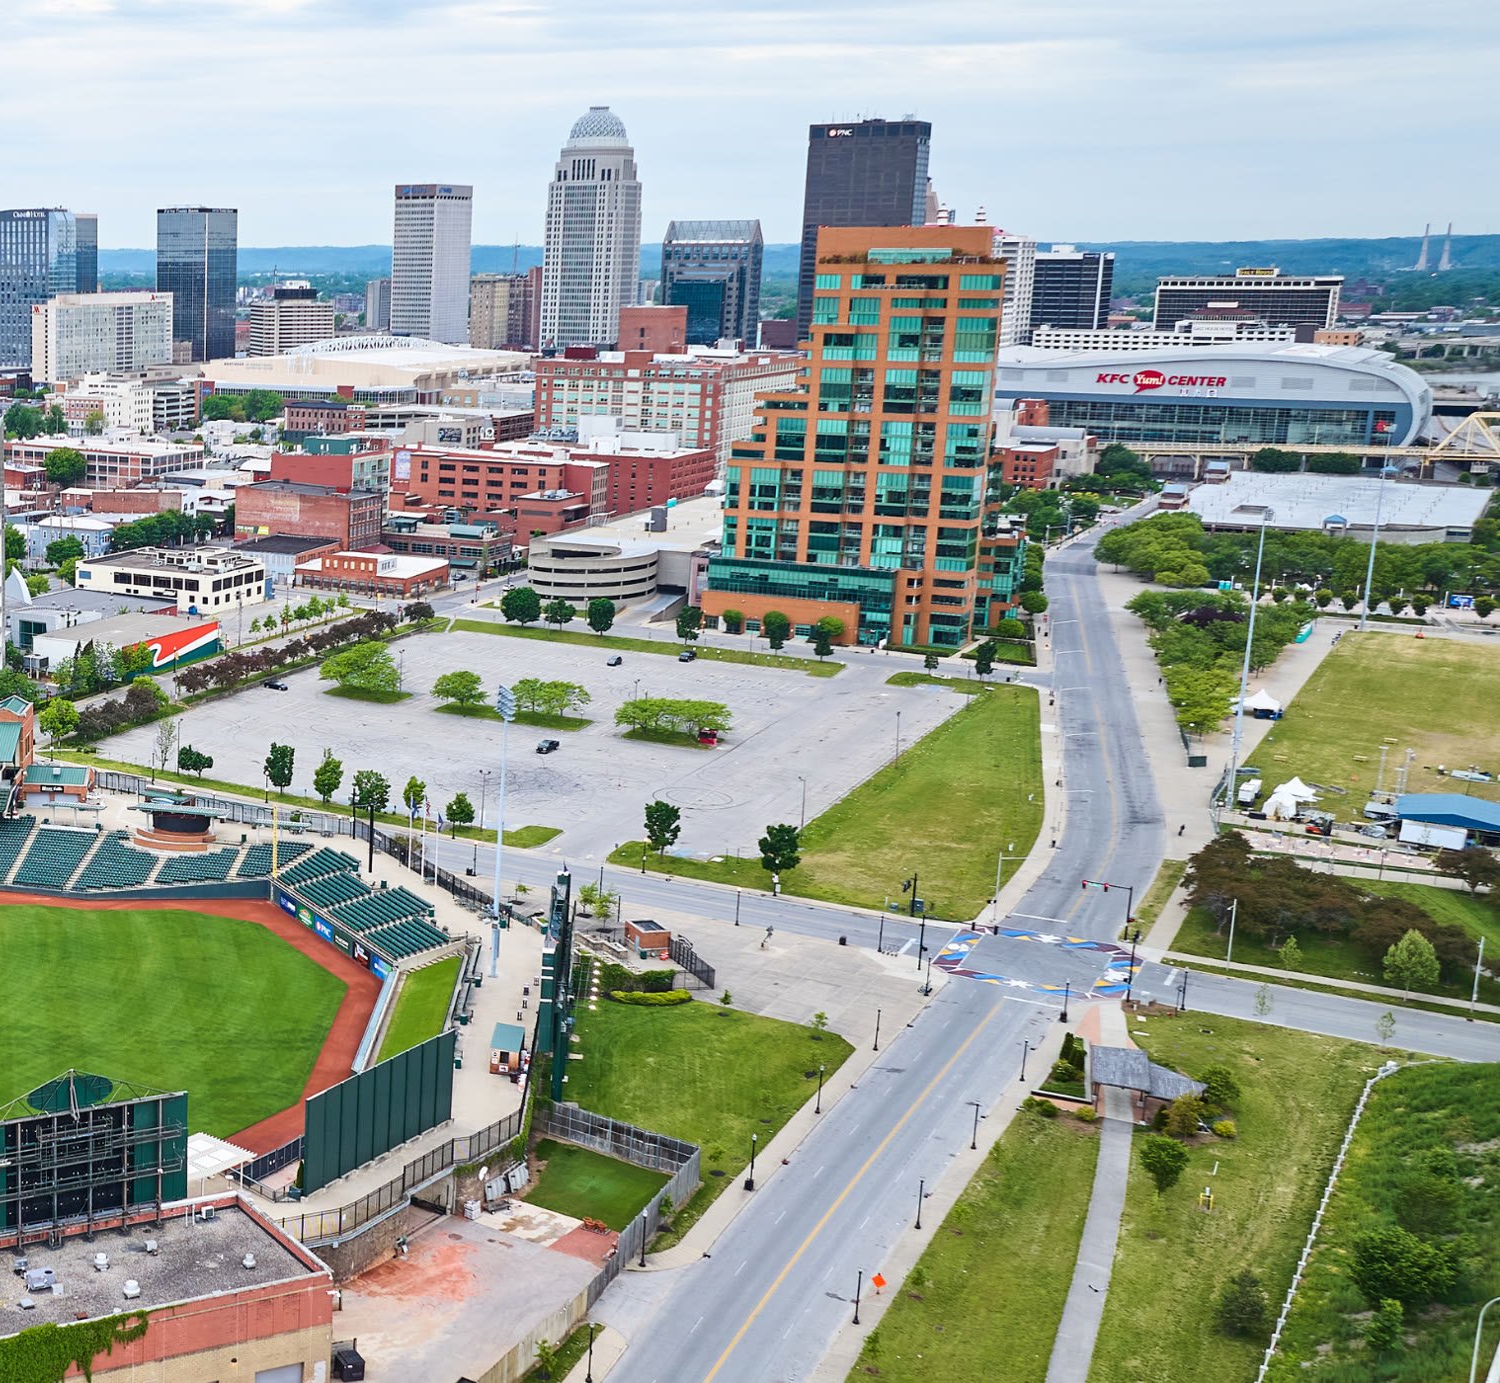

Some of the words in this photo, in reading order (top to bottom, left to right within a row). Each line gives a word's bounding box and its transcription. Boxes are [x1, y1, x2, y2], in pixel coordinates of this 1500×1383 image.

[1096, 373, 1131, 384] KFC
[1135, 374, 1164, 385] Yum!
[1168, 375, 1227, 387] CENTER
